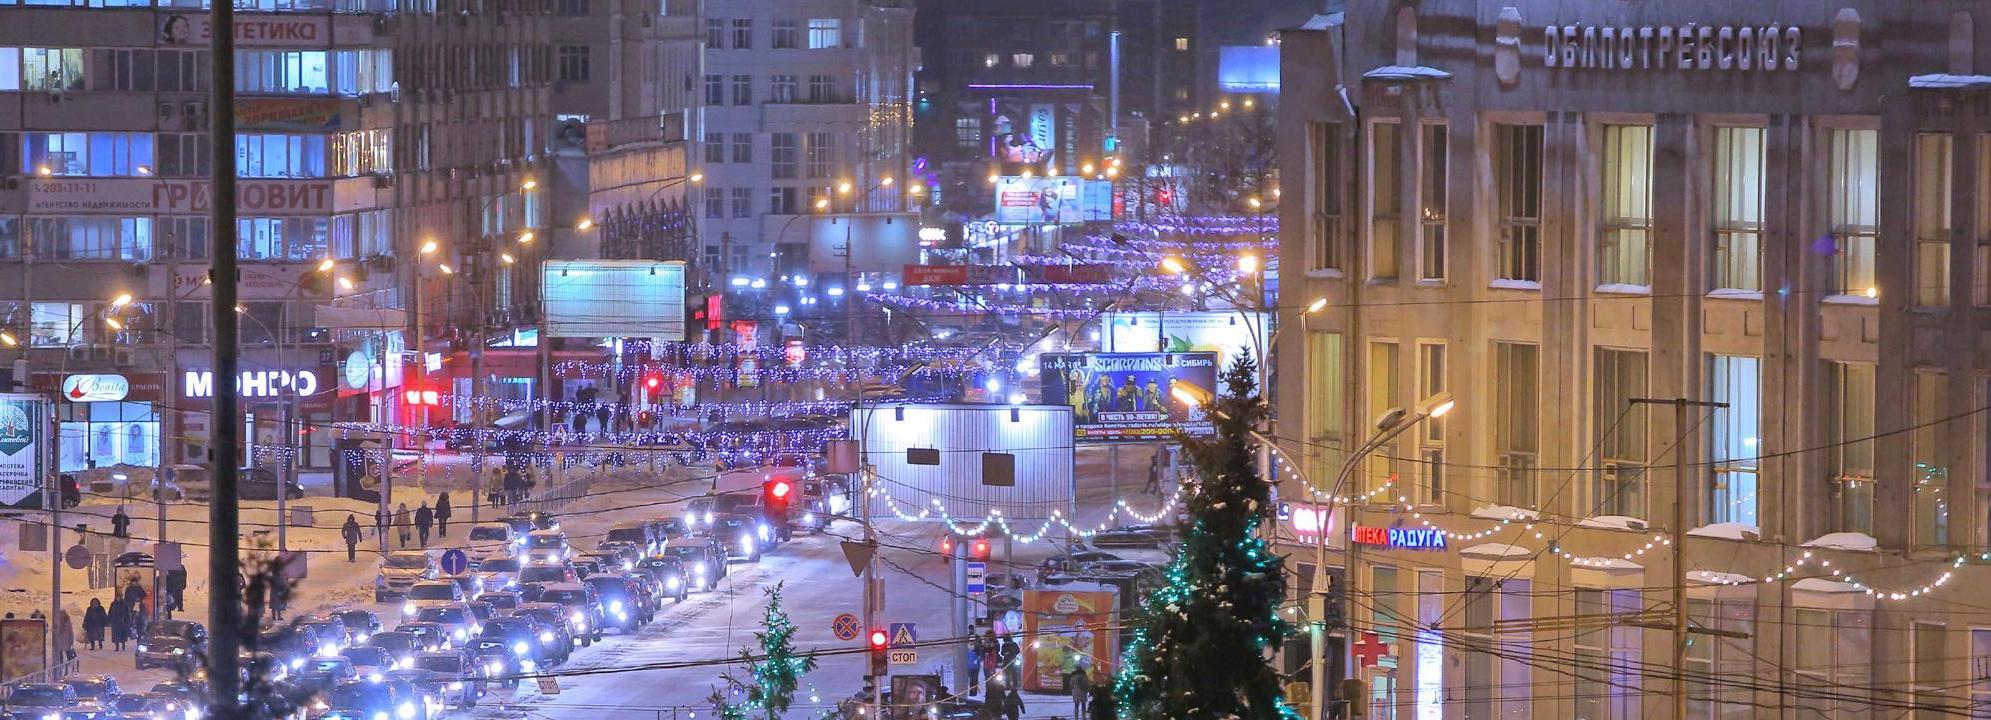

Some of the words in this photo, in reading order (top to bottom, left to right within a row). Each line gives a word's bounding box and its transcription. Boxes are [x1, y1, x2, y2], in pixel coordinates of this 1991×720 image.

[1544, 25, 1800, 70] ОБЛПОТРЕБСОЮЗ
[44, 183, 97, 193] 203-11-11
[1094, 357, 1163, 372] SCORPIONS
[1181, 359, 1213, 368] СИБИРЬ
[185, 370, 317, 397] МНРО
[1390, 529, 1444, 547] РАДУГА
[891, 652, 916, 662] СТОП
